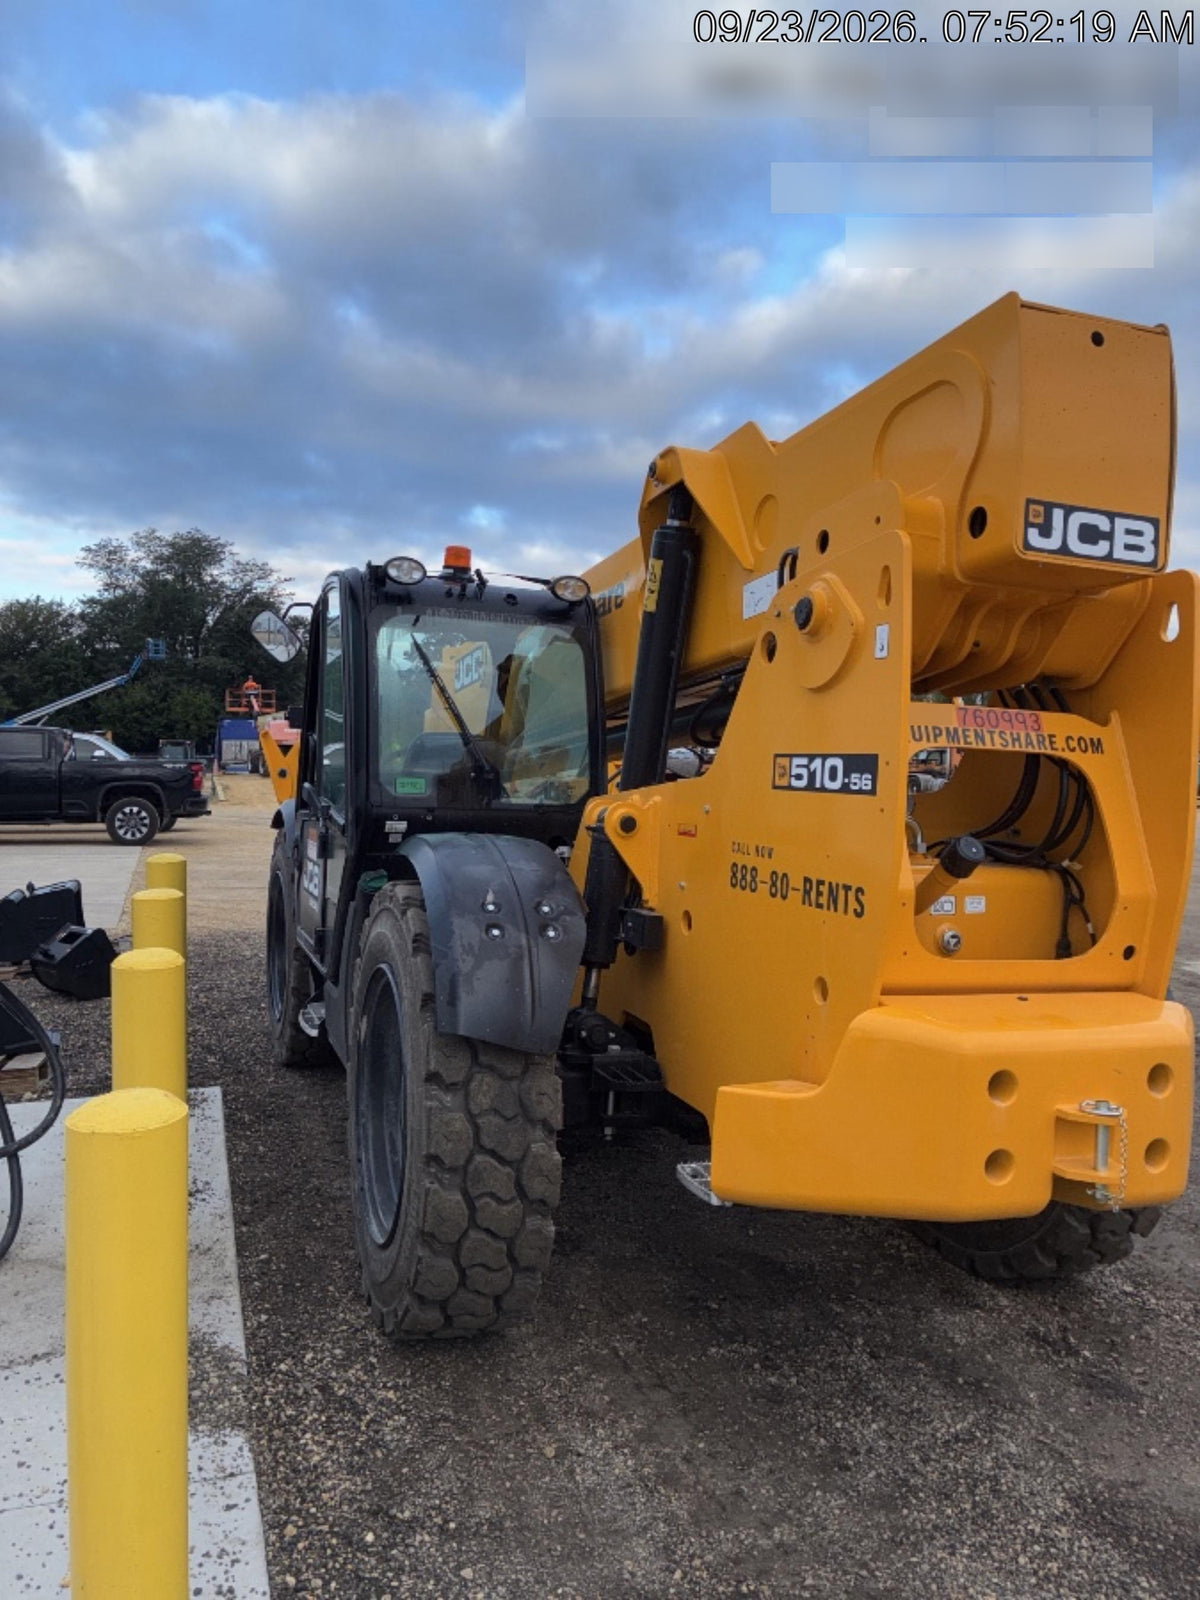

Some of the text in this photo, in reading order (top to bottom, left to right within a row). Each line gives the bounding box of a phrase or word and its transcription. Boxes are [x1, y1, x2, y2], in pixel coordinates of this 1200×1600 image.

[1027, 507, 1155, 563] JCB
[957, 706, 1042, 732] 760993
[909, 725, 1105, 755] UIPMENTSHARE.COM
[731, 841, 774, 859] CALL NOW
[730, 862, 865, 918] 888-80-RENTS
